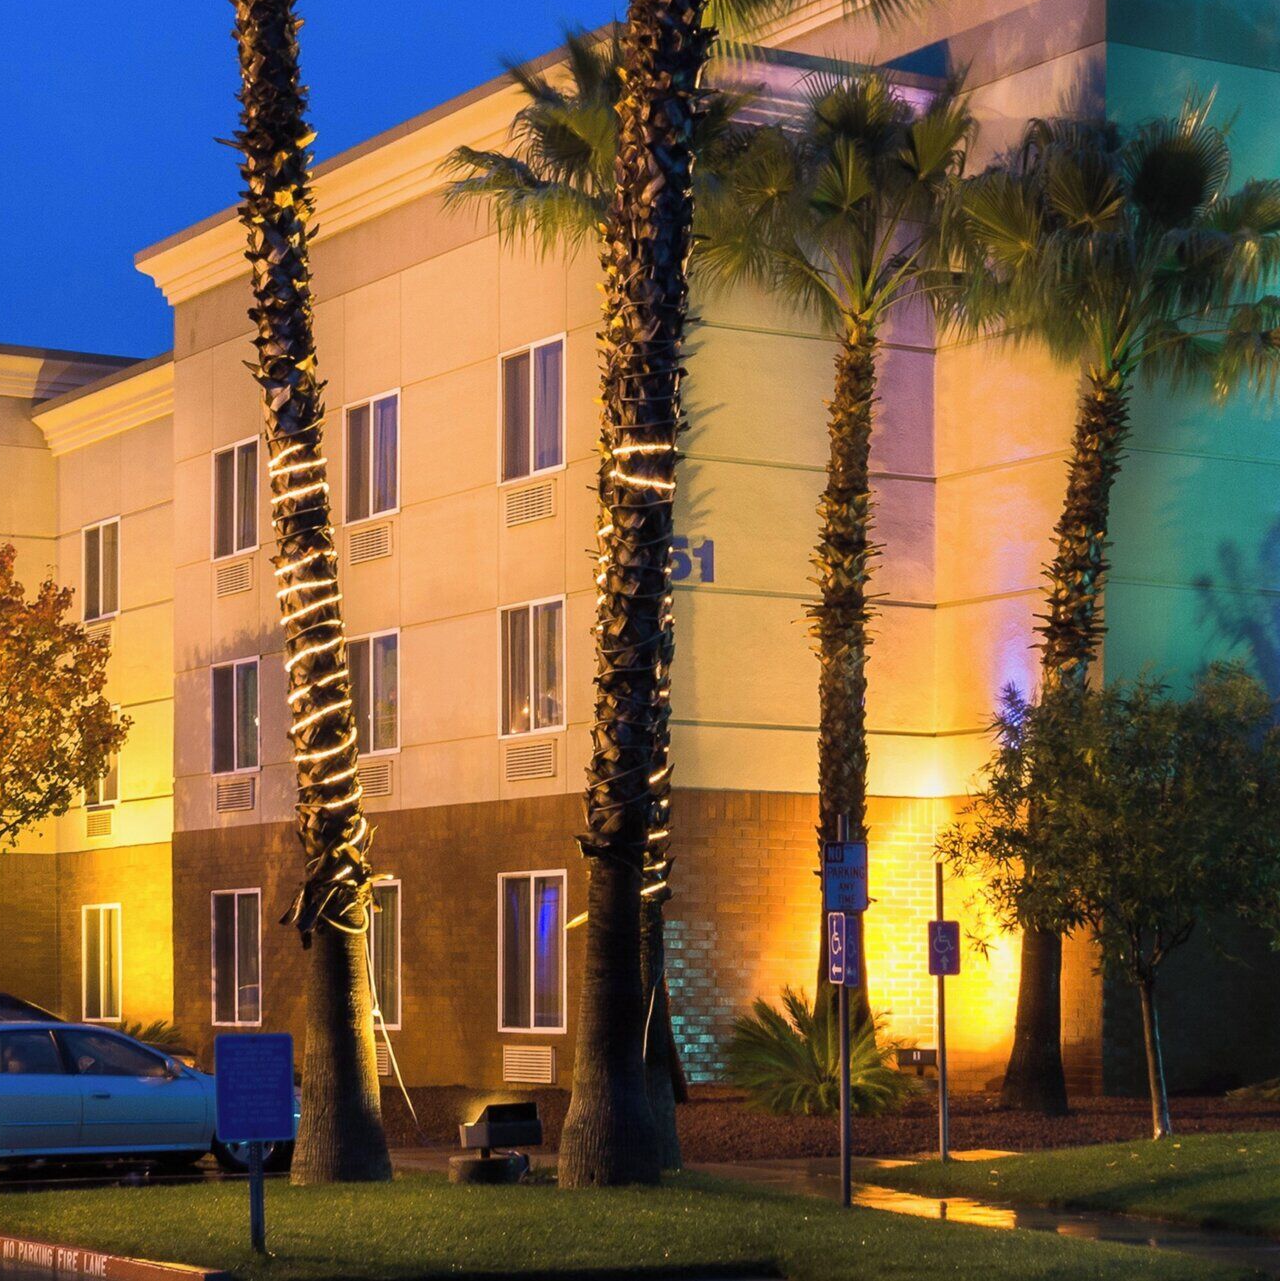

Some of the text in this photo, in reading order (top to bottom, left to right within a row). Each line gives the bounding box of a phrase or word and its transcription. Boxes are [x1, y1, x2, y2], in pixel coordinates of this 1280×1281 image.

[827, 846, 842, 861] NO
[827, 866, 865, 880] PARKING
[839, 882, 855, 891] ANY
[838, 894, 856, 905] TIME
[2, 1240, 107, 1277] NO PARKING FIRE LANE
